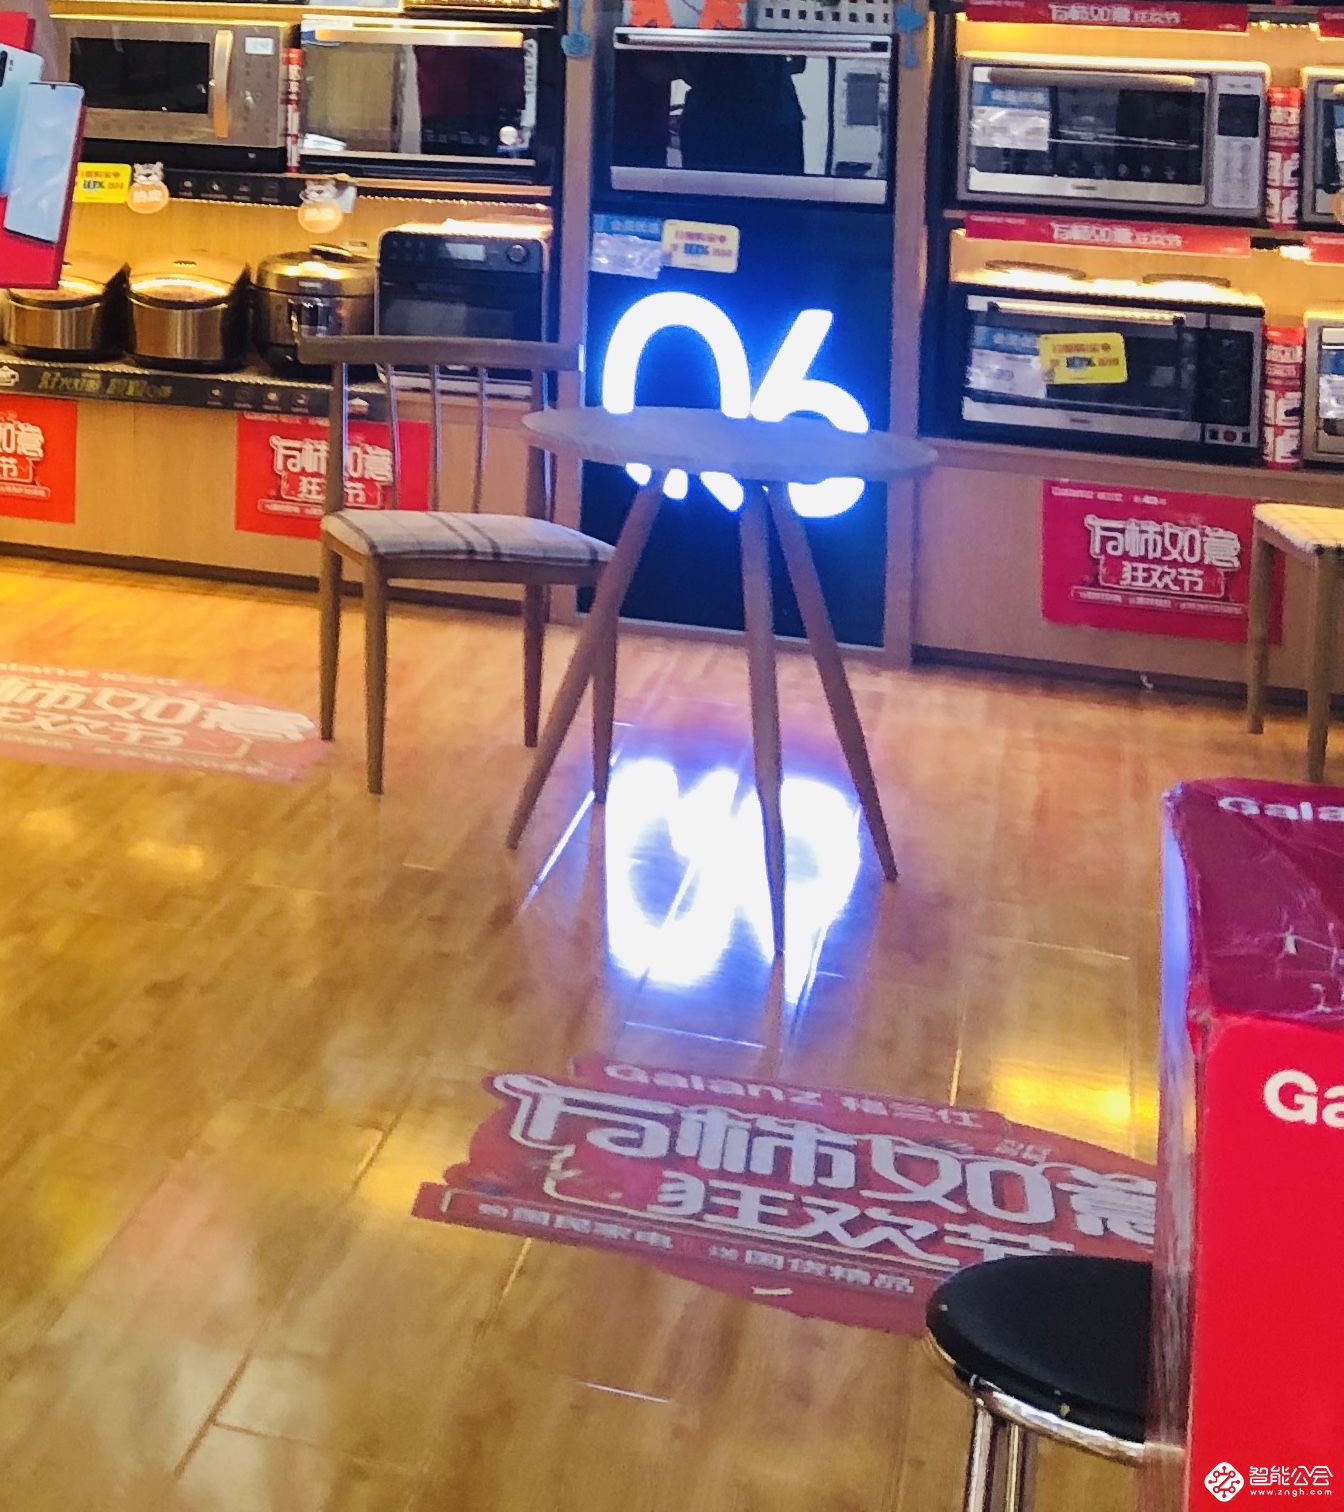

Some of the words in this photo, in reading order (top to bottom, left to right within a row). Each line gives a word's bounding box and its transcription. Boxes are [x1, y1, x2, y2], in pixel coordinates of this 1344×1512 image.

[1119, 560, 1204, 593] 狂欢节
[603, 1063, 826, 1107] Galanz
